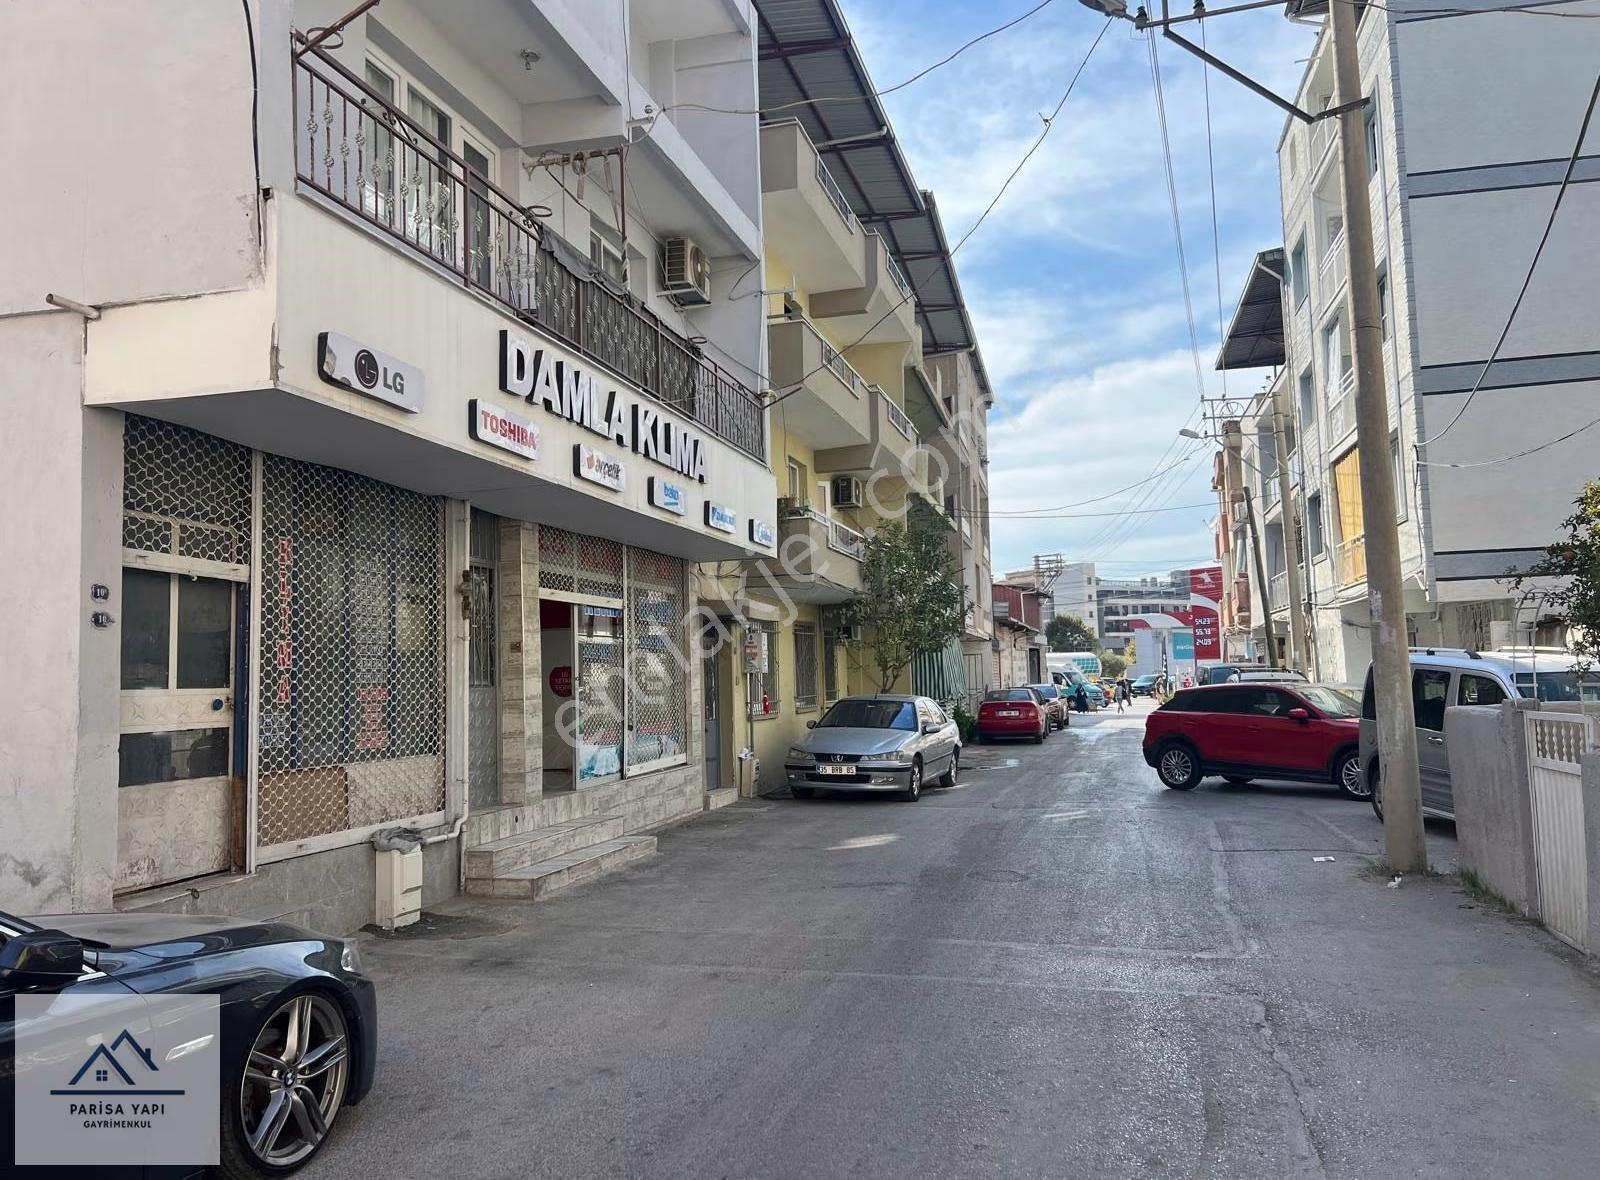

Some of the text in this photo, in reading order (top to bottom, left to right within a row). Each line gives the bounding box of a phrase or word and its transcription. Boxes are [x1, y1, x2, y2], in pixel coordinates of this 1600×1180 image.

[383, 366, 405, 395] LG
[499, 330, 627, 447] DAMLA
[481, 409, 538, 450] TOSHIBA
[595, 459, 622, 481] arçelik
